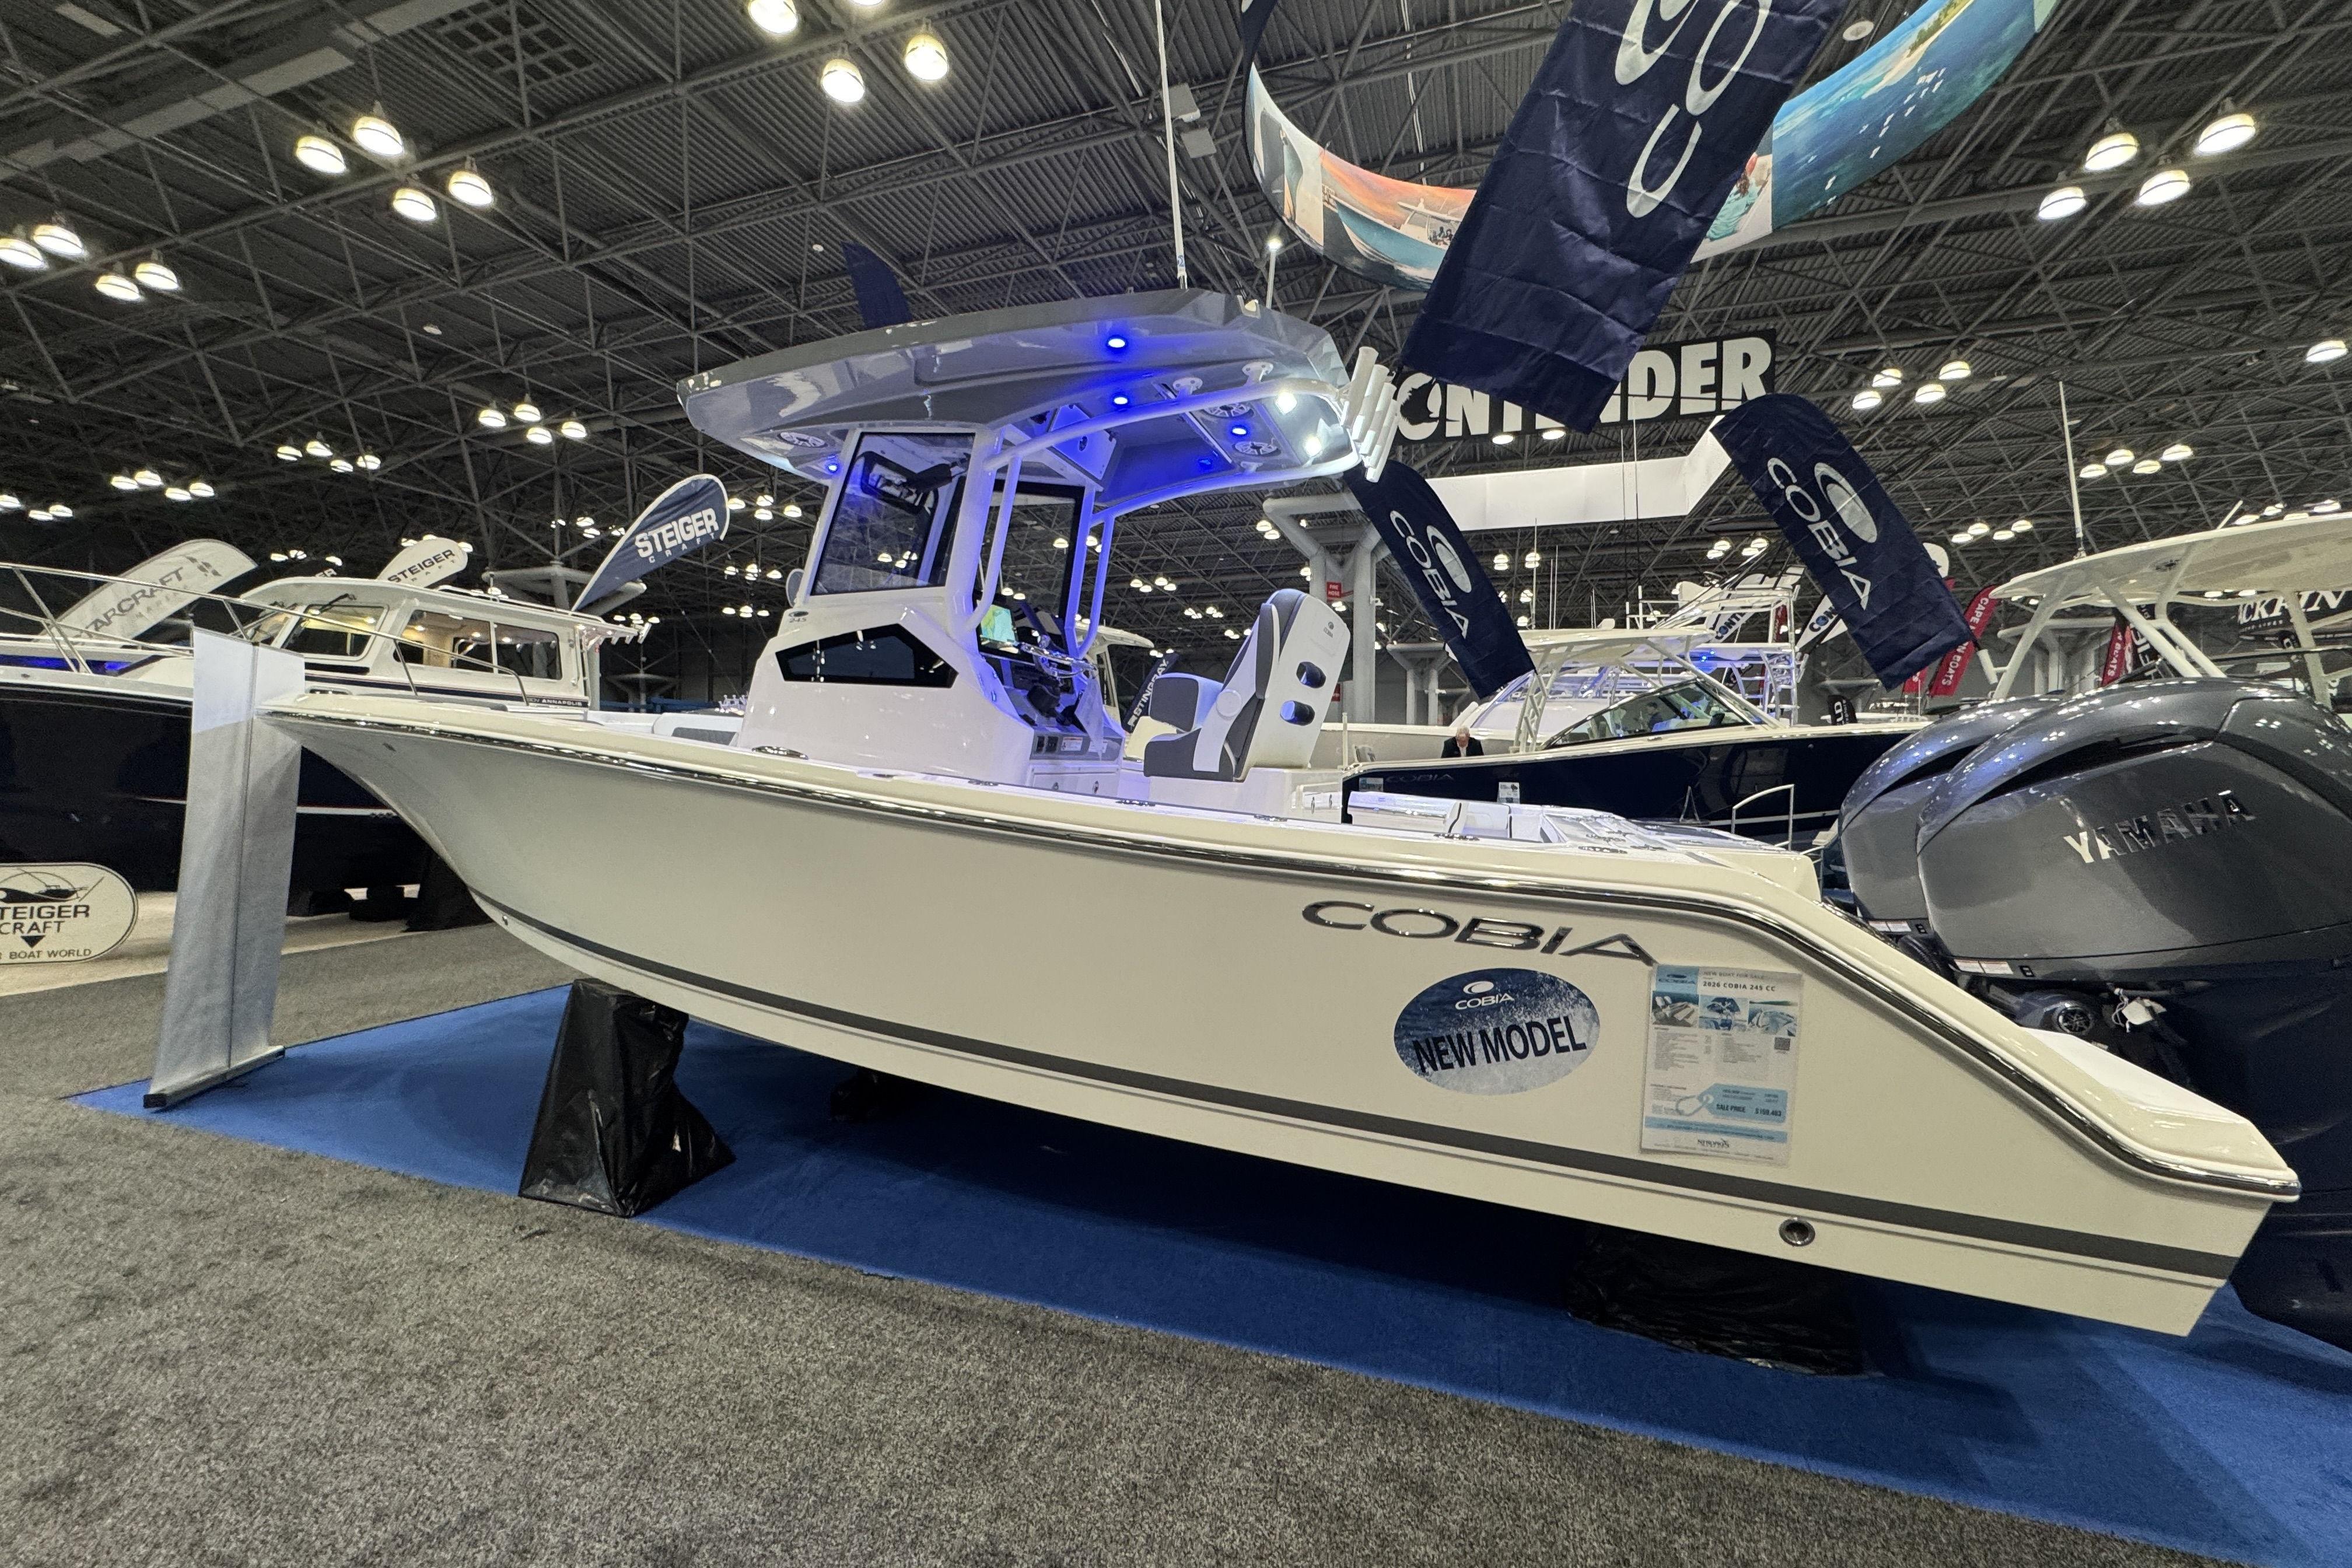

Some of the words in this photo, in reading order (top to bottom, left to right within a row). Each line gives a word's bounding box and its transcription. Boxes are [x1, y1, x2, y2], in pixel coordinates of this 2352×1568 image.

[635, 508, 719, 558] STEIGER
[649, 533, 715, 564] CRAFT
[1768, 458, 1871, 610] COBIA
[387, 549, 455, 583] STEIGER
[411, 558, 456, 582] RAFT
[1390, 510, 1469, 639] COBIA
[71, 566, 184, 646] TARCRAFT
[1969, 597, 1989, 624] CAPE
[1941, 654, 1962, 685] BOATS
[2063, 790, 2256, 863] YAMAHA
[0, 921, 65, 935] CRAFT
[1302, 901, 1658, 967] COBIA
[9, 950, 43, 960] BOAT
[47, 949, 92, 958] WORLD
[1455, 993, 1515, 1010] COBIA
[1412, 1031, 1476, 1073] NEW
[1479, 1016, 1587, 1064] MODEL
